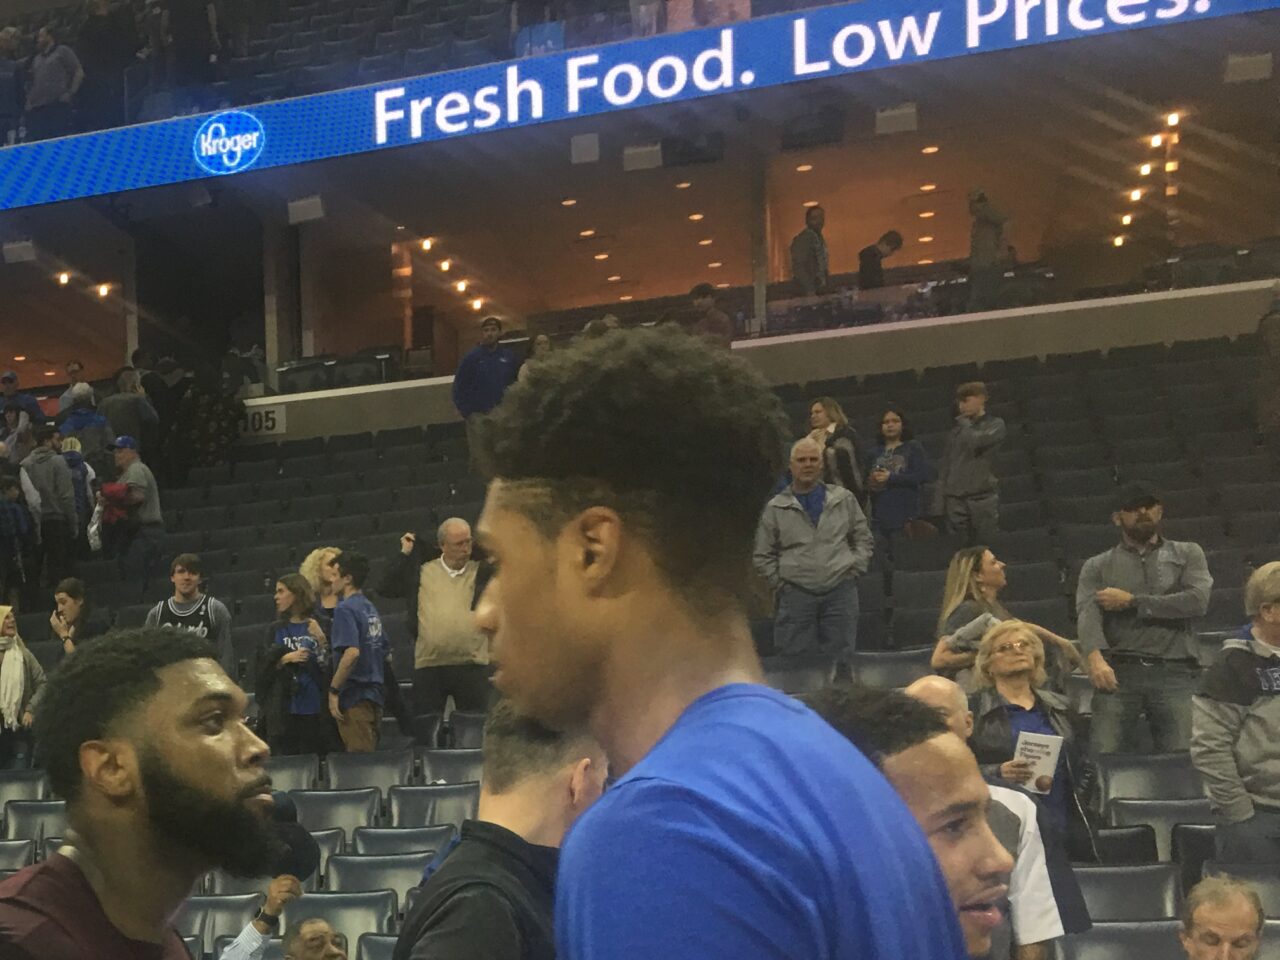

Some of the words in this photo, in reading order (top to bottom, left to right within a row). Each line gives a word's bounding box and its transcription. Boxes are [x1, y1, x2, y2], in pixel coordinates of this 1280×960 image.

[374, 64, 543, 145] Fresh
[566, 27, 755, 113] Food.
[793, 11, 942, 76] Low
[200, 122, 260, 166] Kroger
